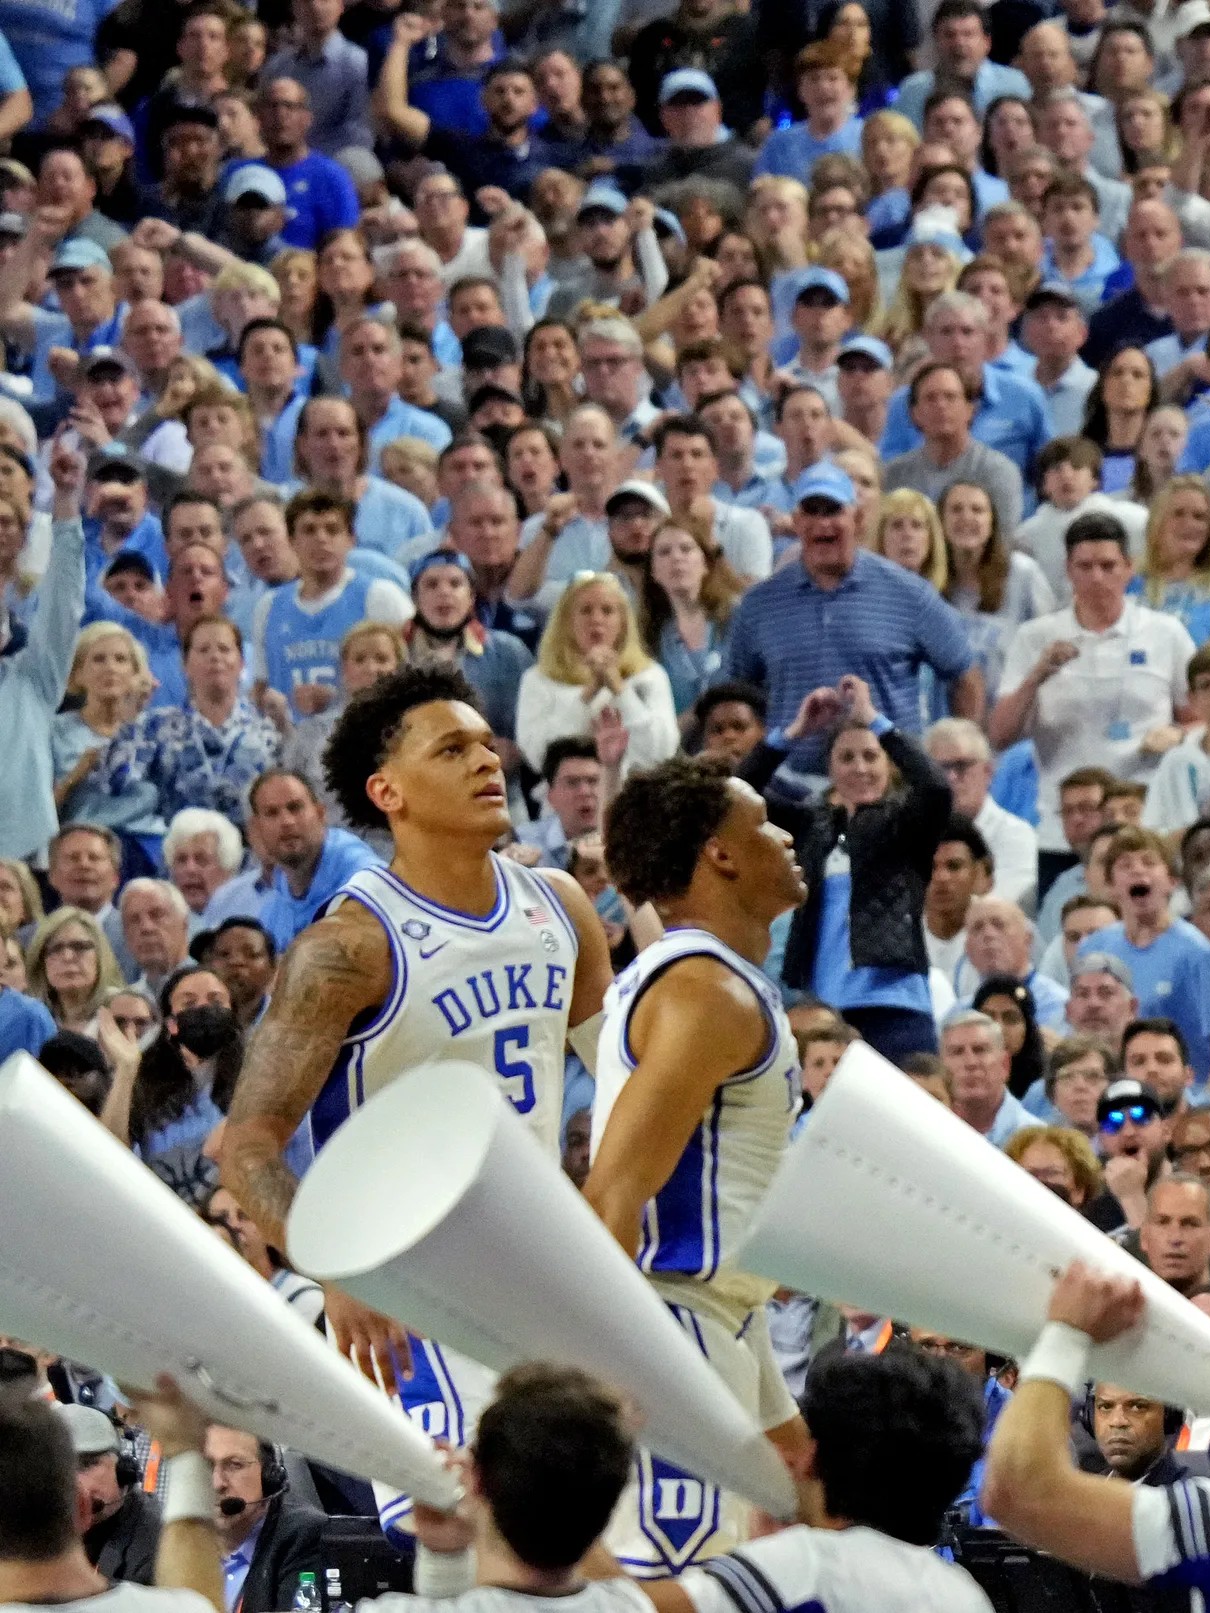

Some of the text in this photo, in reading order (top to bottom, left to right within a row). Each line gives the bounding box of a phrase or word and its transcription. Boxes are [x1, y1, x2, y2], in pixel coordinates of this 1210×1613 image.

[432, 962, 567, 1037] DUKE
[494, 1024, 536, 1114] 5
[656, 1478, 703, 1519] D
